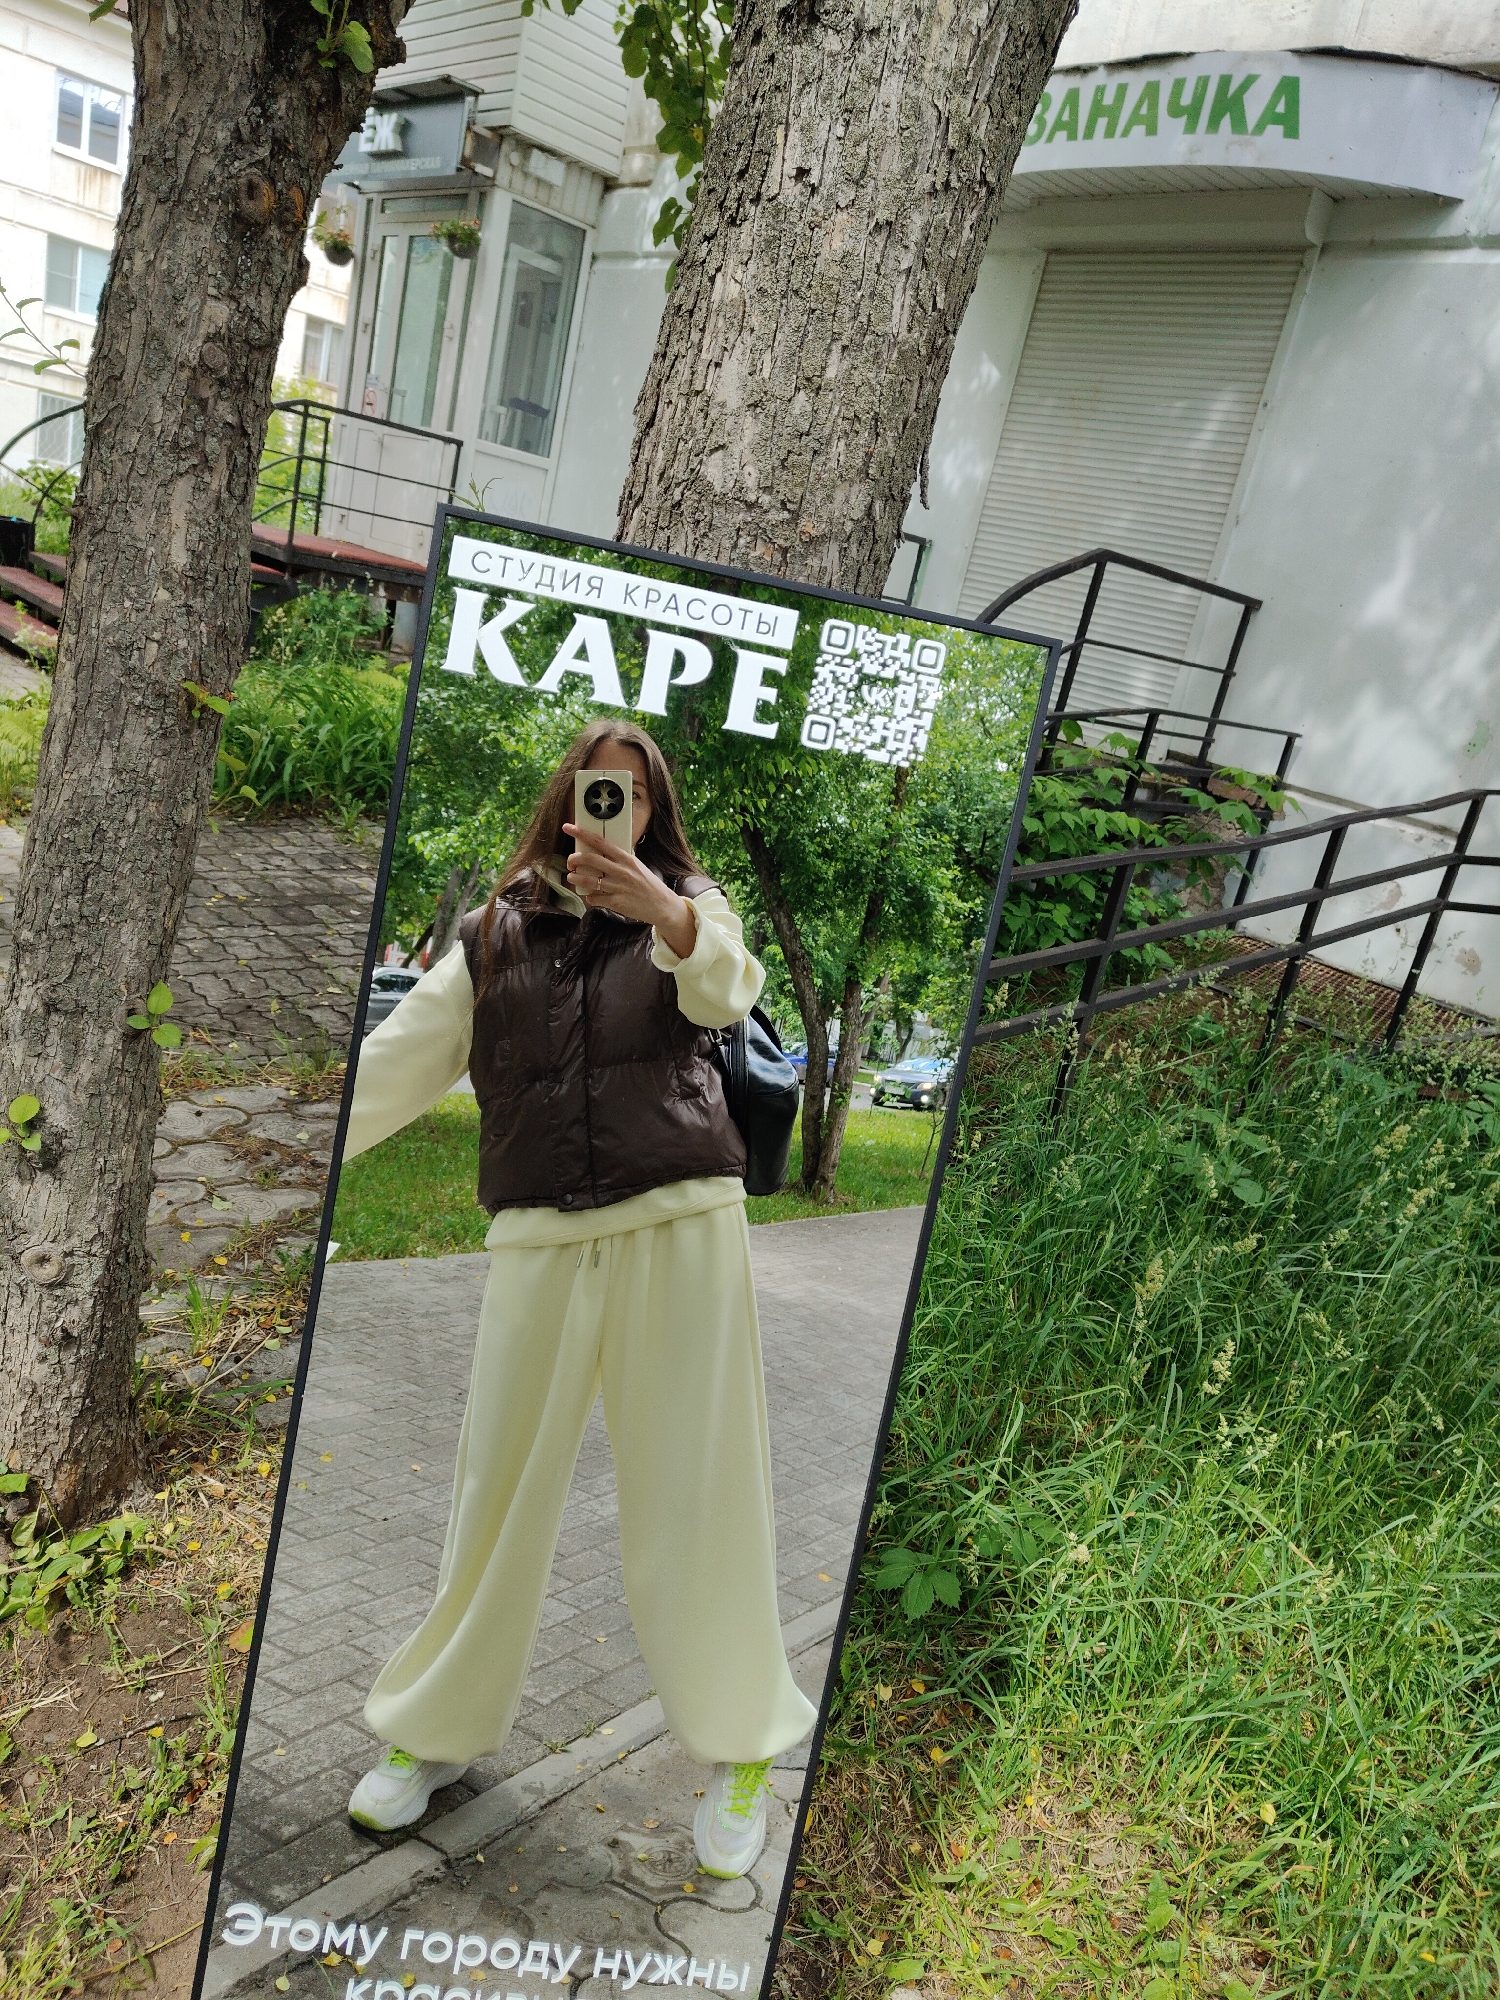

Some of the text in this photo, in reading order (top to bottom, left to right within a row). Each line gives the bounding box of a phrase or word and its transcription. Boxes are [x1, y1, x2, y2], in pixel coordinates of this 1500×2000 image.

[471, 550, 779, 638] СТУДИЯ КРАСОТЫ
[440, 586, 789, 740] КАРЕ
[221, 1902, 750, 1992] Этому городу нужны
